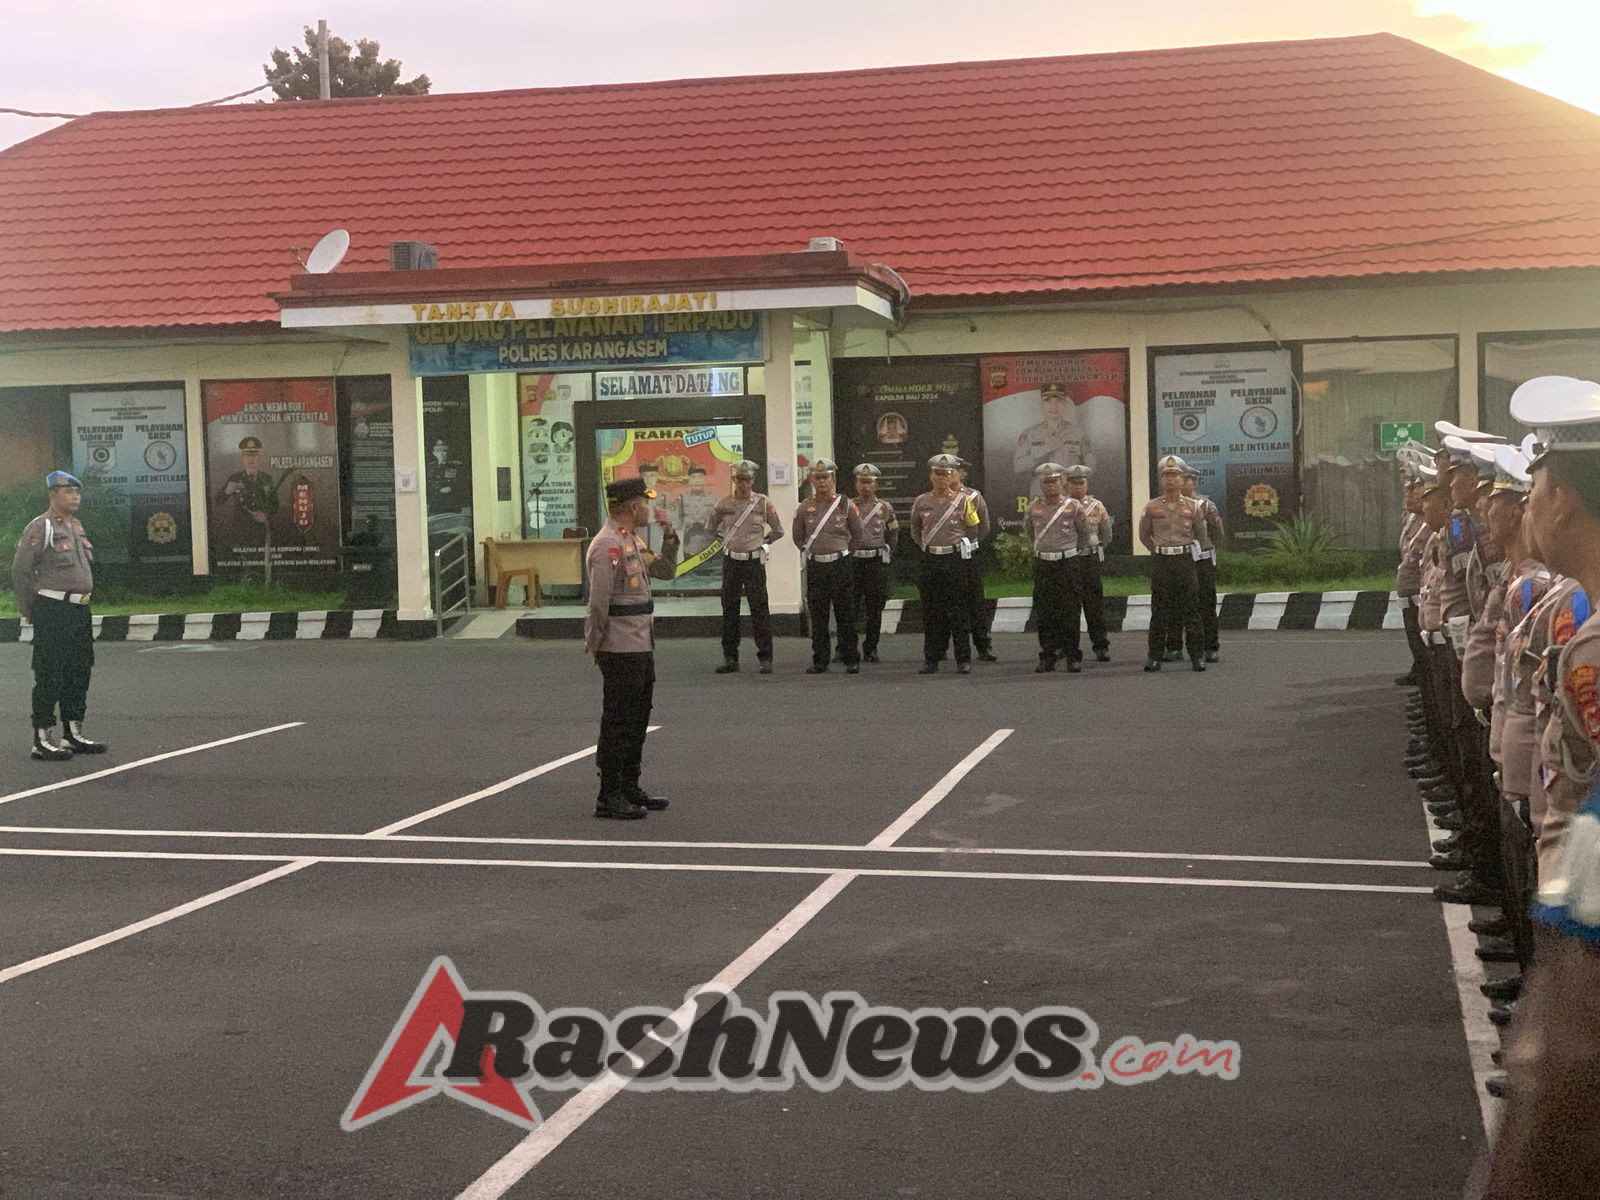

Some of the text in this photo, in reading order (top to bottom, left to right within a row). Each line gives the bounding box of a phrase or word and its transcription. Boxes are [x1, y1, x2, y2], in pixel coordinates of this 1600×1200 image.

[412, 292, 718, 321] TANTYA SUDHIRAJATI
[415, 310, 753, 345] GEDUNG PELAYANAN TERPADU
[499, 339, 668, 364] POLRES KARANGASEM
[600, 371, 740, 397] SELAMAT DATANG
[1161, 390, 1217, 400] PELAYANAN
[1230, 387, 1286, 397] PELAYANAN
[1163, 400, 1192, 408] SIDIK
[1244, 397, 1273, 406] SKCK
[243, 403, 263, 413] ANDA
[686, 428, 716, 446] TUTUP
[1161, 446, 1178, 455] SAT
[1228, 444, 1244, 452] SAT
